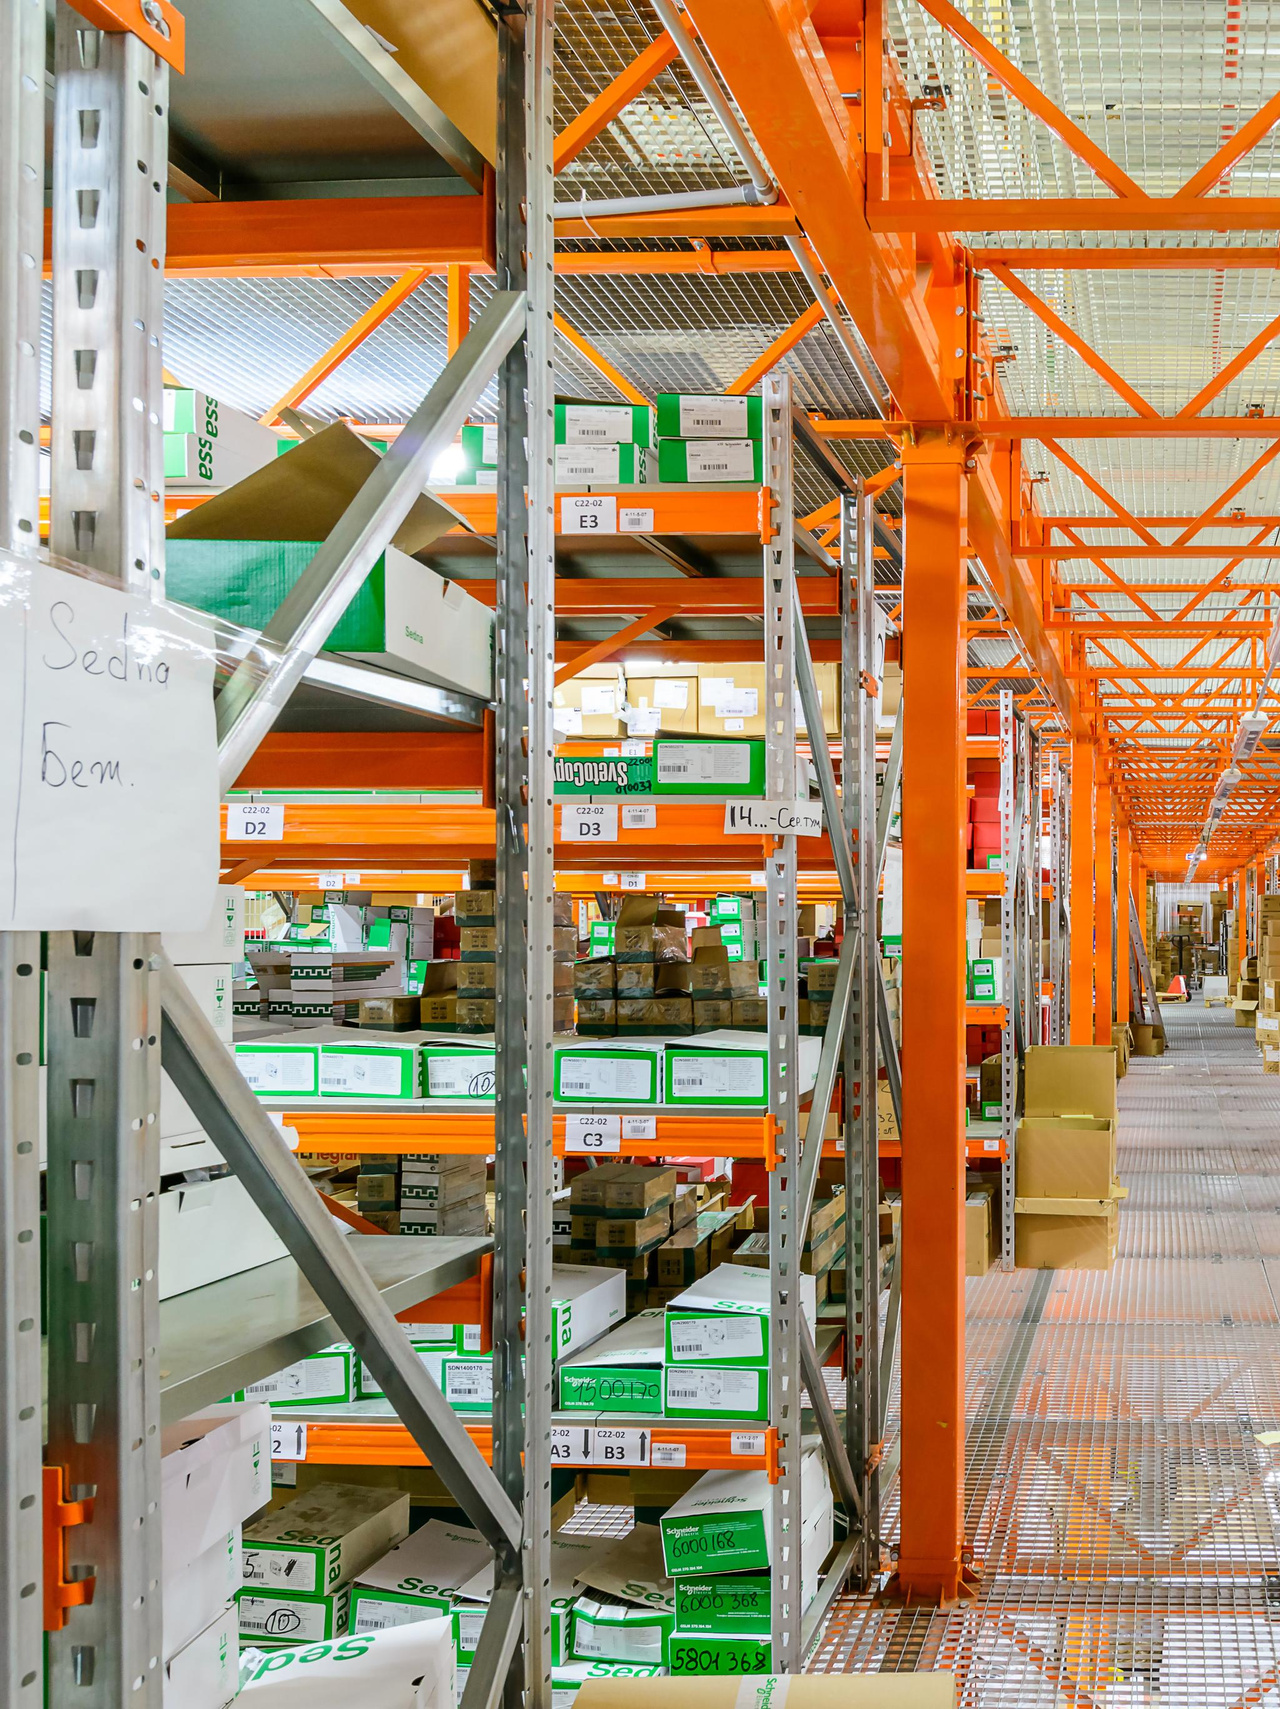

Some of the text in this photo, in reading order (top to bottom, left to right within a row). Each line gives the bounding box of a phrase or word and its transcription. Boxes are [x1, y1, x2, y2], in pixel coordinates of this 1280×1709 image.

[574, 499, 603, 508] C22-02
[579, 515, 599, 530] E3
[242, 805, 270, 815] C22-02
[576, 807, 604, 816] C22-02
[243, 820, 267, 836] D2
[579, 822, 602, 837] D3
[325, 880, 336, 888] D2
[579, 1117, 607, 1126] C22-02
[582, 1132, 603, 1147] C3
[596, 1431, 626, 1439] C22-02
[550, 1449, 571, 1464] A3
[604, 1446, 626, 1460] B3
[666, 1526, 700, 1539] Schneider
[679, 1584, 713, 1597] Schneider
[680, 1592, 760, 1614] 6000 368
[670, 1648, 767, 1673] 5801 368
